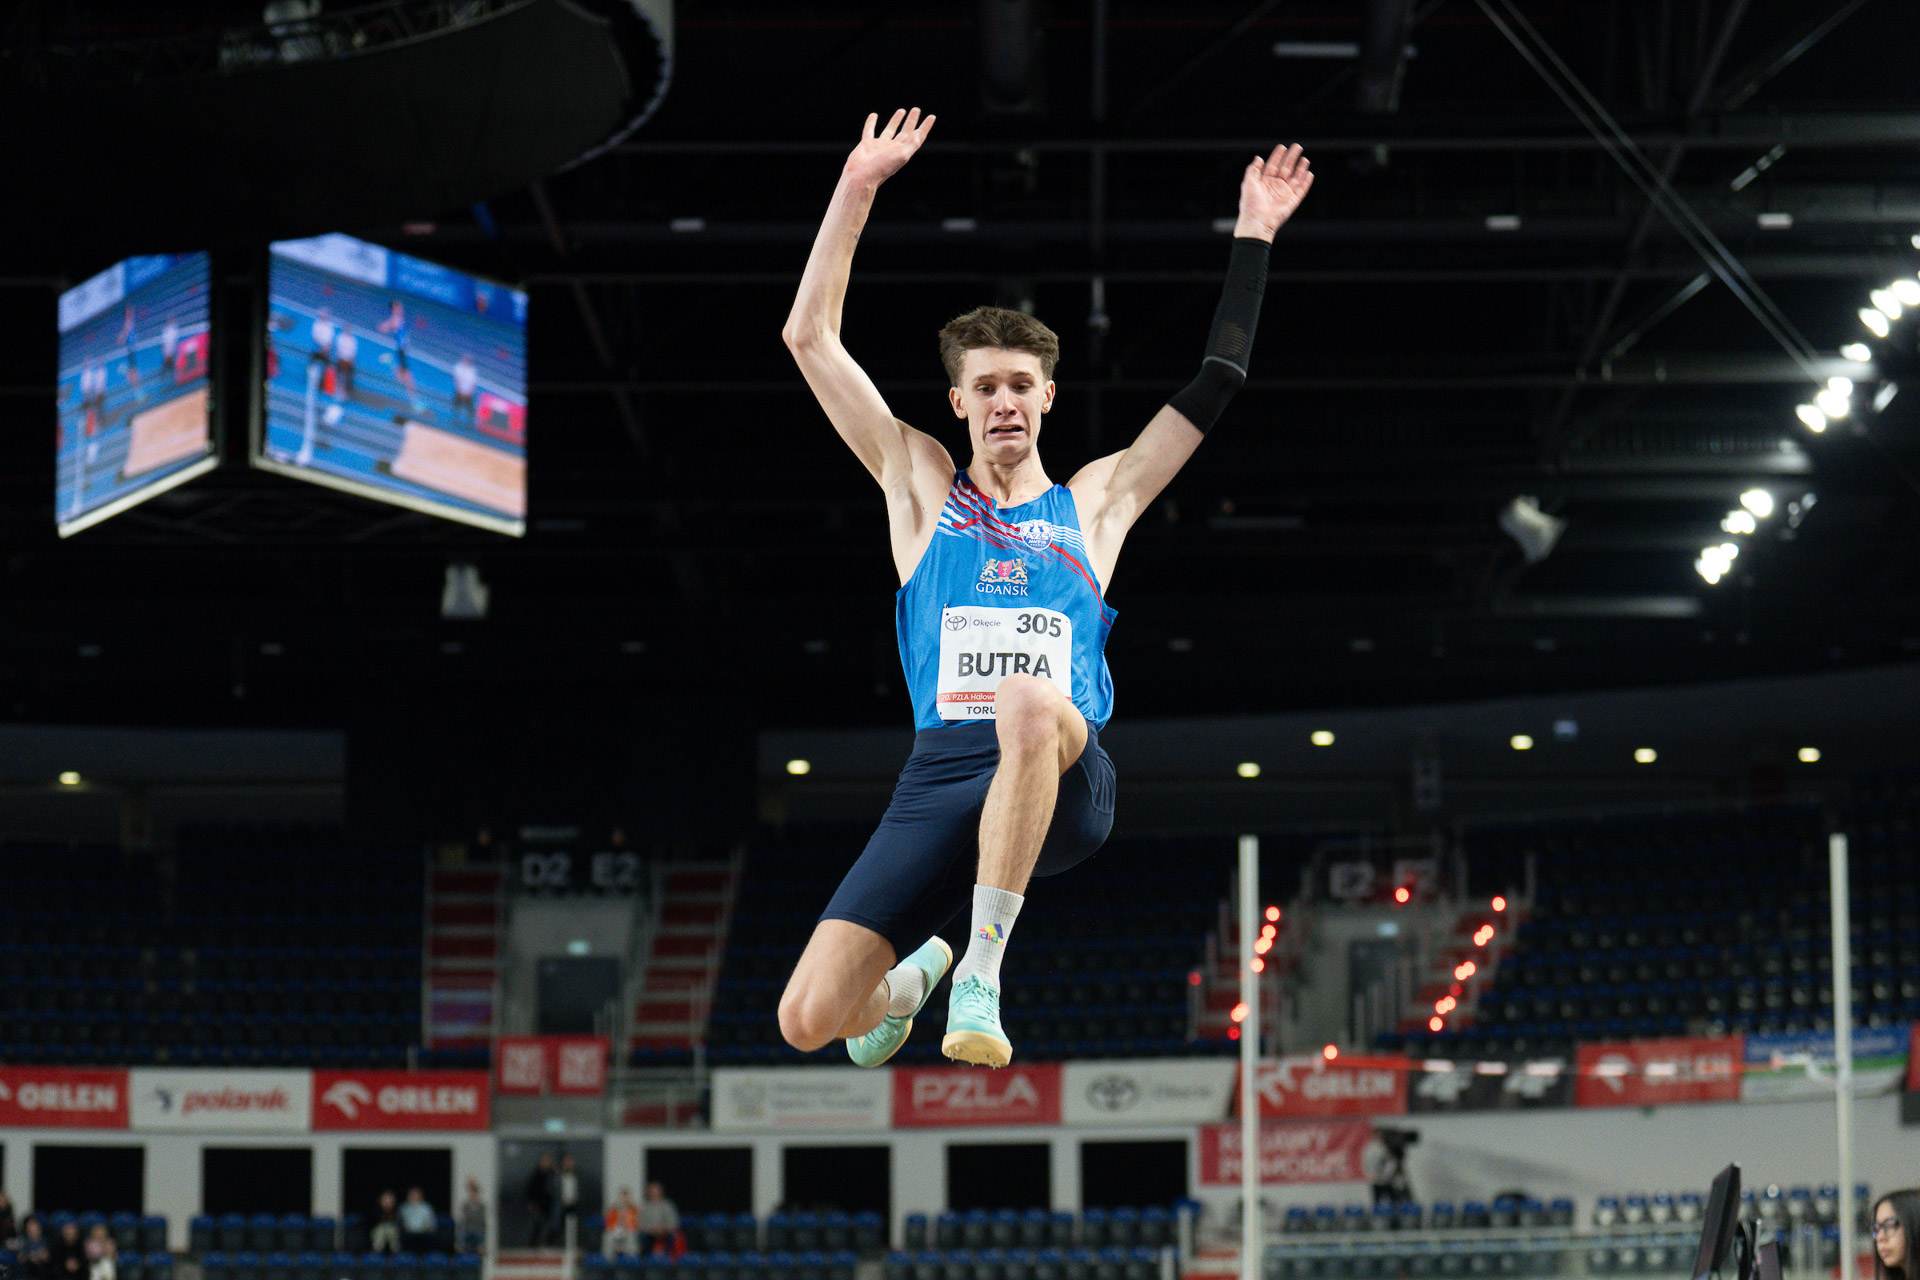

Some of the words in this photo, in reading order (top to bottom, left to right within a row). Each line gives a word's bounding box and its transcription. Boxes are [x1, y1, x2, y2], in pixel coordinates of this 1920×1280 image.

[976, 582, 1029, 597] GDAŃSK
[972, 618, 1001, 627] Okęcie
[1016, 613, 1062, 638] 305
[958, 652, 1052, 679] BUTRA
[953, 694, 970, 702] PZLA
[522, 852, 571, 887] D2
[17, 1082, 118, 1113] ORLEN
[912, 1073, 1041, 1108] PZLA
[1302, 1069, 1396, 1099] ORLEN
[376, 1085, 479, 1114] ORLEN
